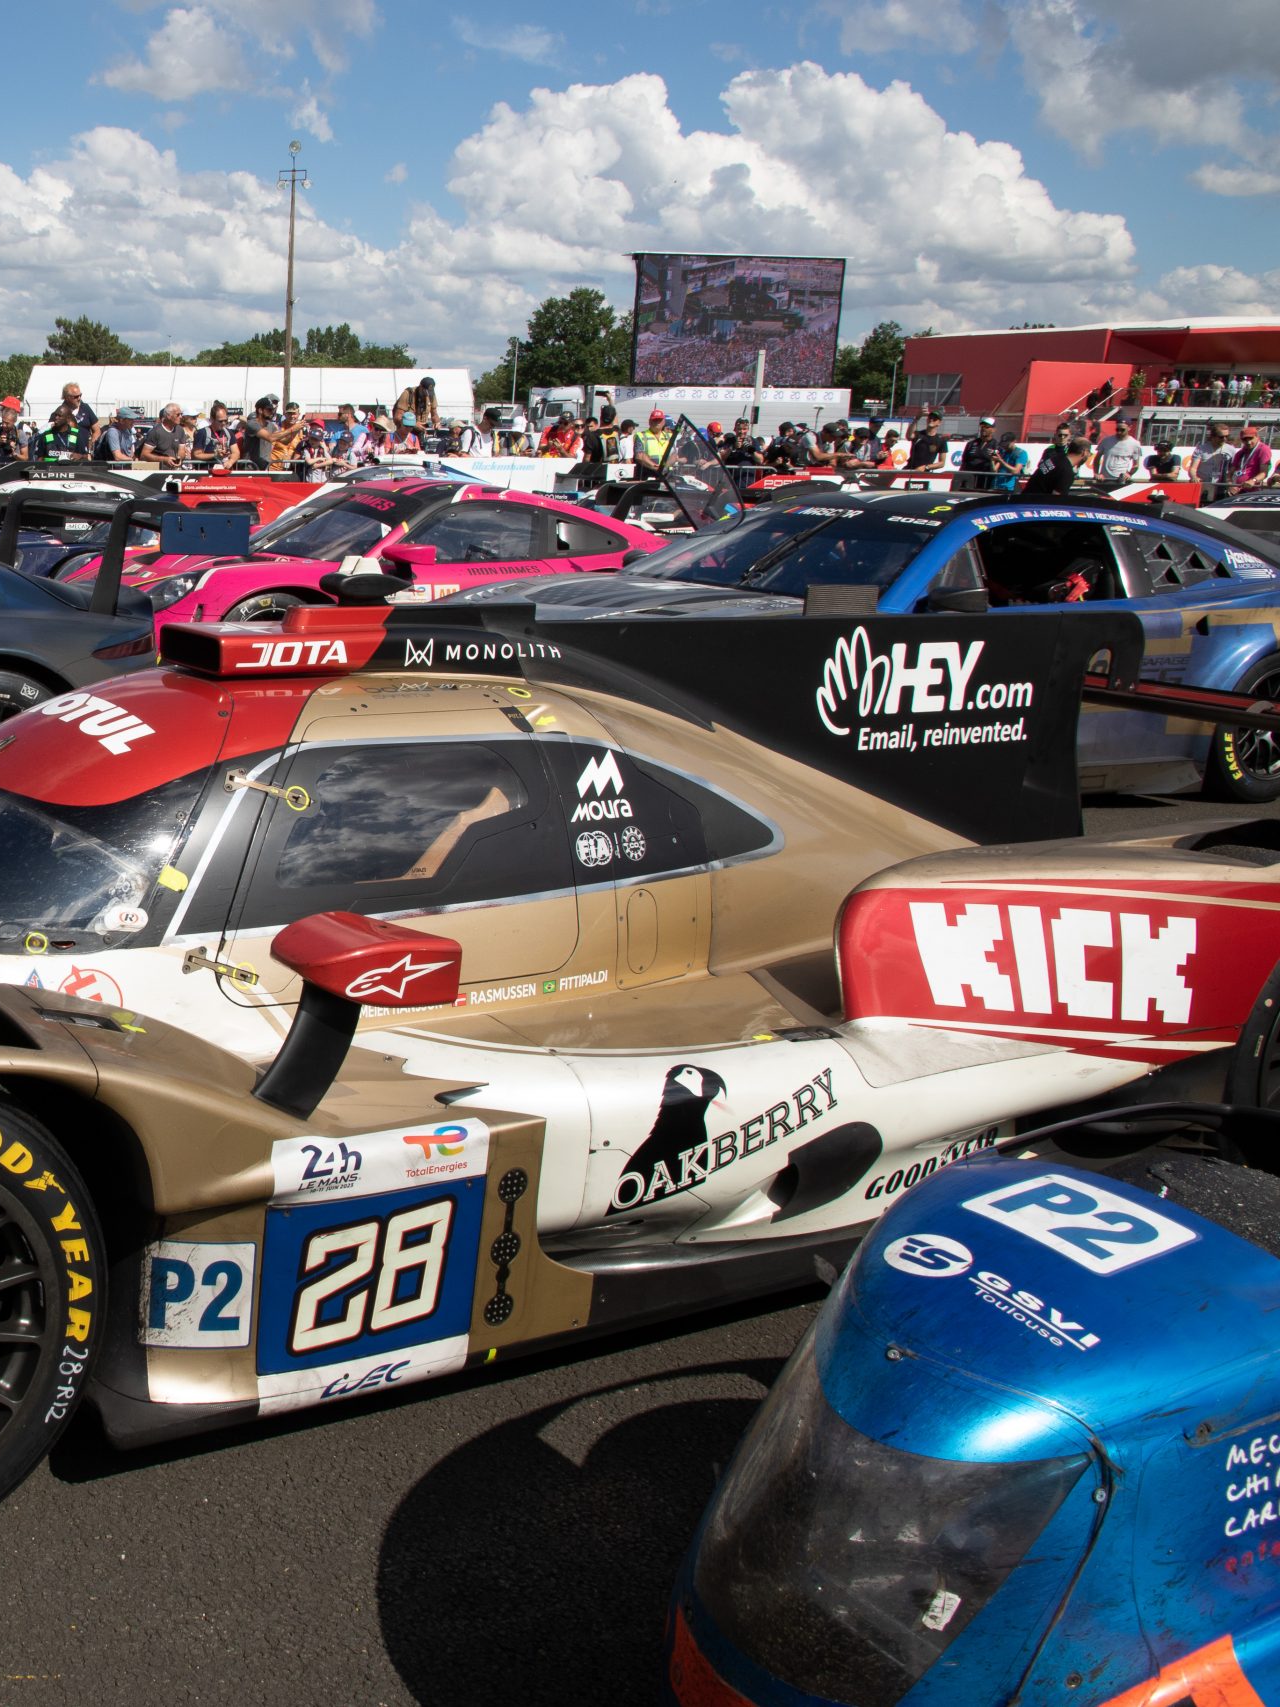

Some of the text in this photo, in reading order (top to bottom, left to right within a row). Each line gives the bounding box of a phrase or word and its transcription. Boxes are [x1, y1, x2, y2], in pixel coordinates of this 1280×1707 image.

[887, 515, 942, 527] 2023
[990, 512, 1018, 523] BUTTON
[468, 565, 541, 576] IRON DAMES
[235, 641, 562, 669] JOTA MONOLITH
[26, 692, 157, 756] OTUL
[857, 716, 1028, 753] Email, reinvented.
[1224, 732, 1244, 780] EAGLE
[559, 969, 609, 992] FITTIPALDI
[908, 901, 1198, 1024] KICK
[470, 983, 537, 1005] RASMUSSEN
[611, 1067, 838, 1210] OAKBERRY
[300, 1142, 363, 1181] 24h
[405, 1160, 469, 1179] TotalEnergies
[297, 1172, 359, 1192] LE MANS
[987, 1181, 1160, 1261] P2
[148, 1256, 244, 1333] P2
[290, 1198, 456, 1353] 28
[974, 1285, 1064, 1348] Toulouse
[976, 1270, 1102, 1348] GSVI
[1224, 1500, 1280, 1537] CAR
